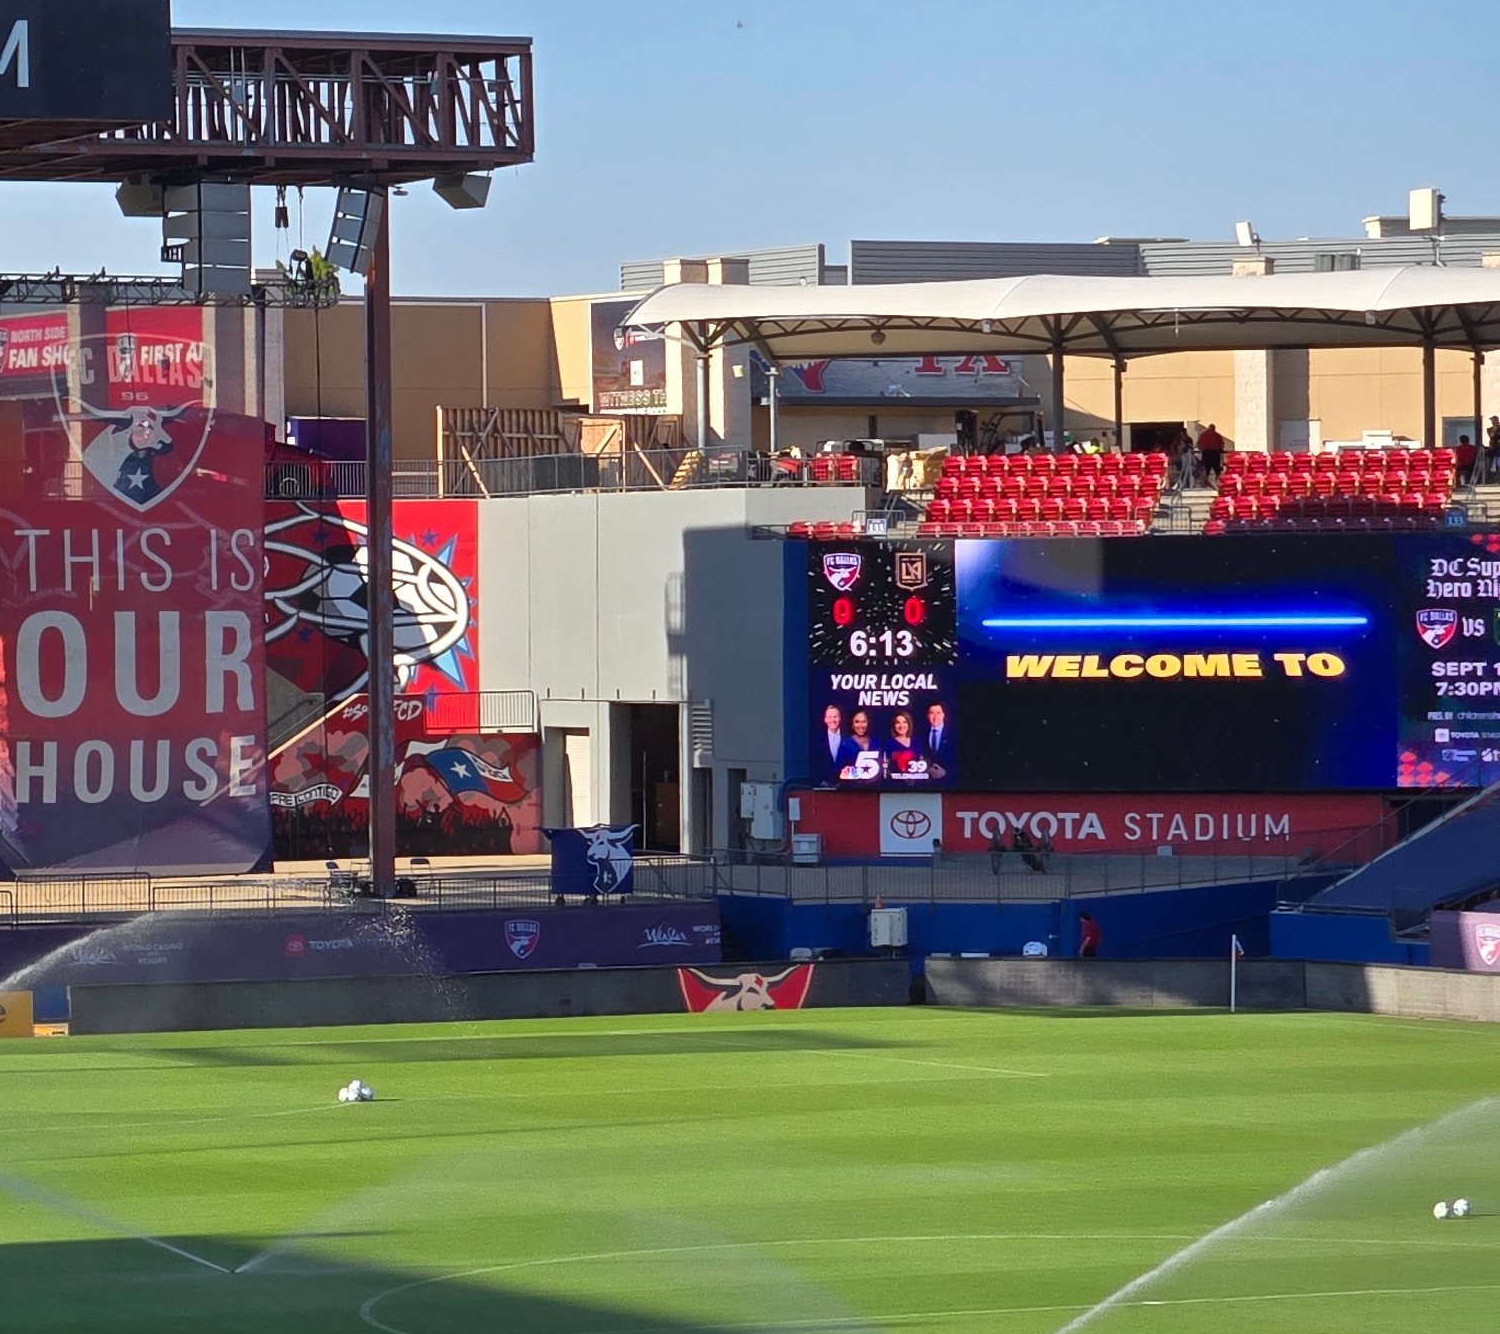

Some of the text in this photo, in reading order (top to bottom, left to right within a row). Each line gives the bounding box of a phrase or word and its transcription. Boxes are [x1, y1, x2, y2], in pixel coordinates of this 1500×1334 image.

[8, 345, 71, 369] FAN SHO
[141, 343, 184, 366] FIRST
[120, 390, 150, 402] 96
[13, 527, 255, 592] THIS IS
[1426, 578, 1473, 599] Hero
[833, 597, 851, 626] 0
[904, 597, 923, 626] 0
[850, 629, 914, 657] 6:13
[15, 609, 256, 718] OUR
[1006, 652, 1346, 678] WELCOME TO
[1431, 661, 1487, 677] SEPT
[830, 673, 938, 690] YOUR LOCAL
[858, 690, 910, 706] NEWS
[15, 734, 258, 805] HOUSE
[855, 750, 880, 780] 5
[907, 760, 927, 773] 39
[955, 811, 1290, 842] TOYOTA STADIUM
